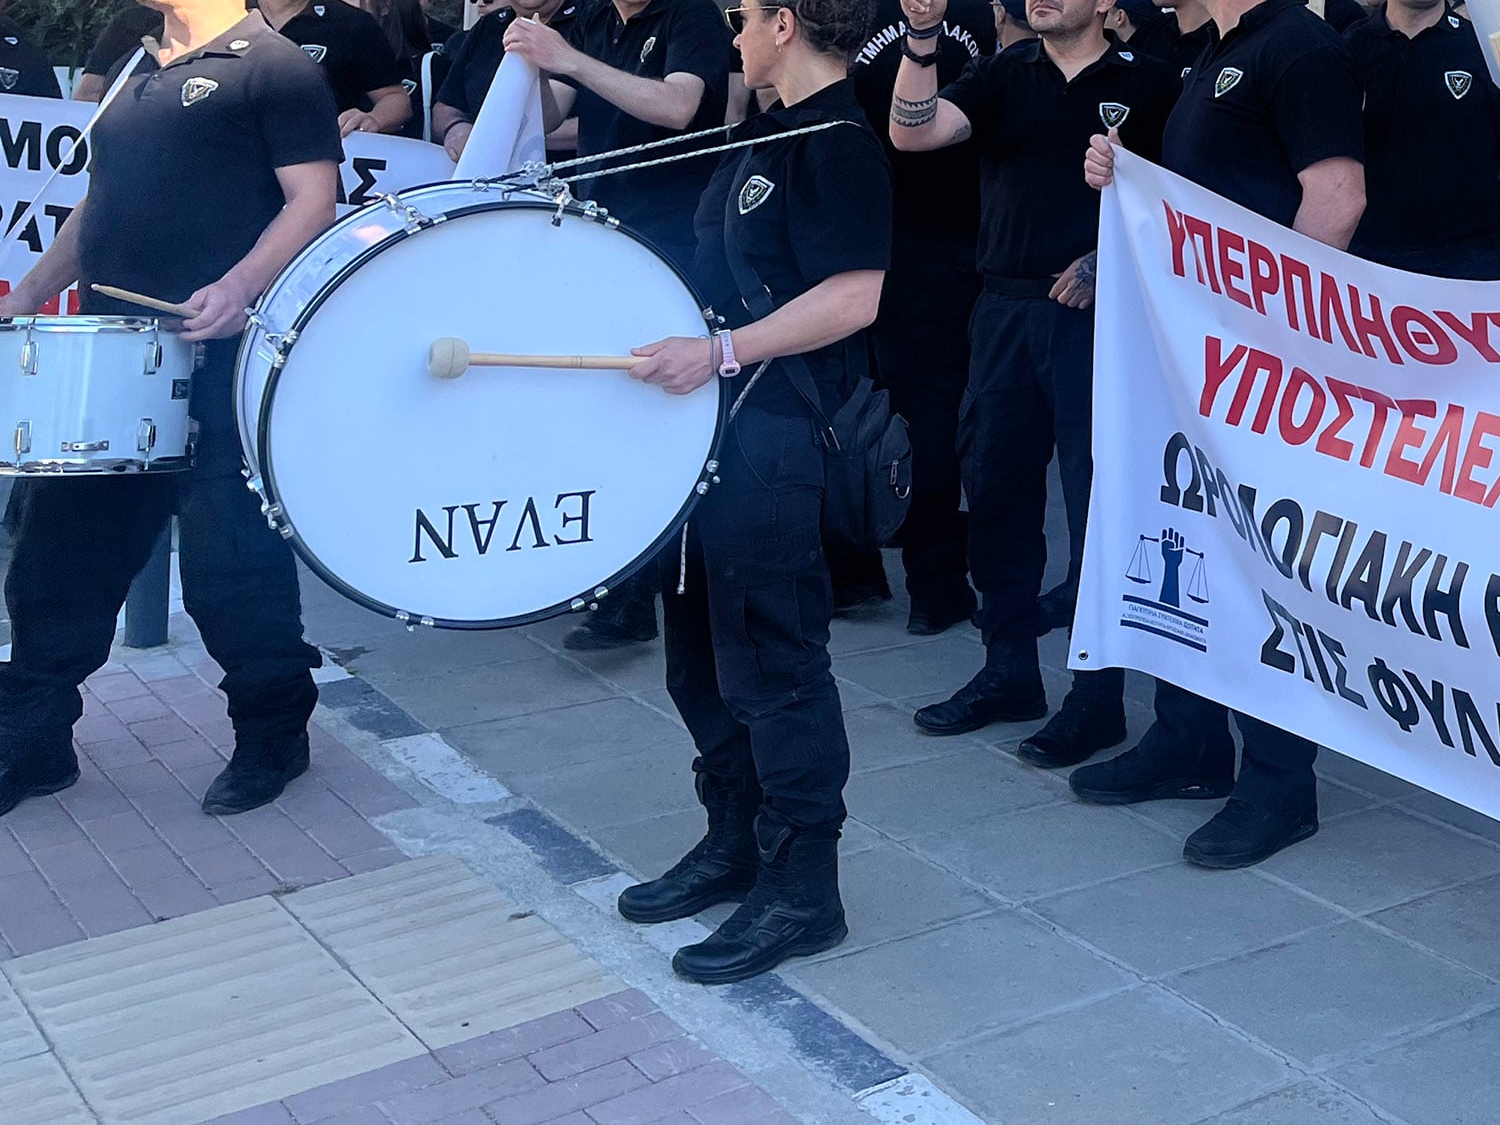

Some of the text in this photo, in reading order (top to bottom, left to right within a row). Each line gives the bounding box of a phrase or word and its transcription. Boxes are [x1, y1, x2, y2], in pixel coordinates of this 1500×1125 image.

[855, 20, 907, 65] ΤΜΗΜΑ
[336, 157, 387, 206] Σ
[0, 201, 75, 253] ΑΤ
[408, 490, 596, 563] EVAN
[1160, 431, 1469, 649] ΩΡΟΛΟΓΙΑΚΗ
[1260, 588, 1368, 710] ΣΤΙΣ
